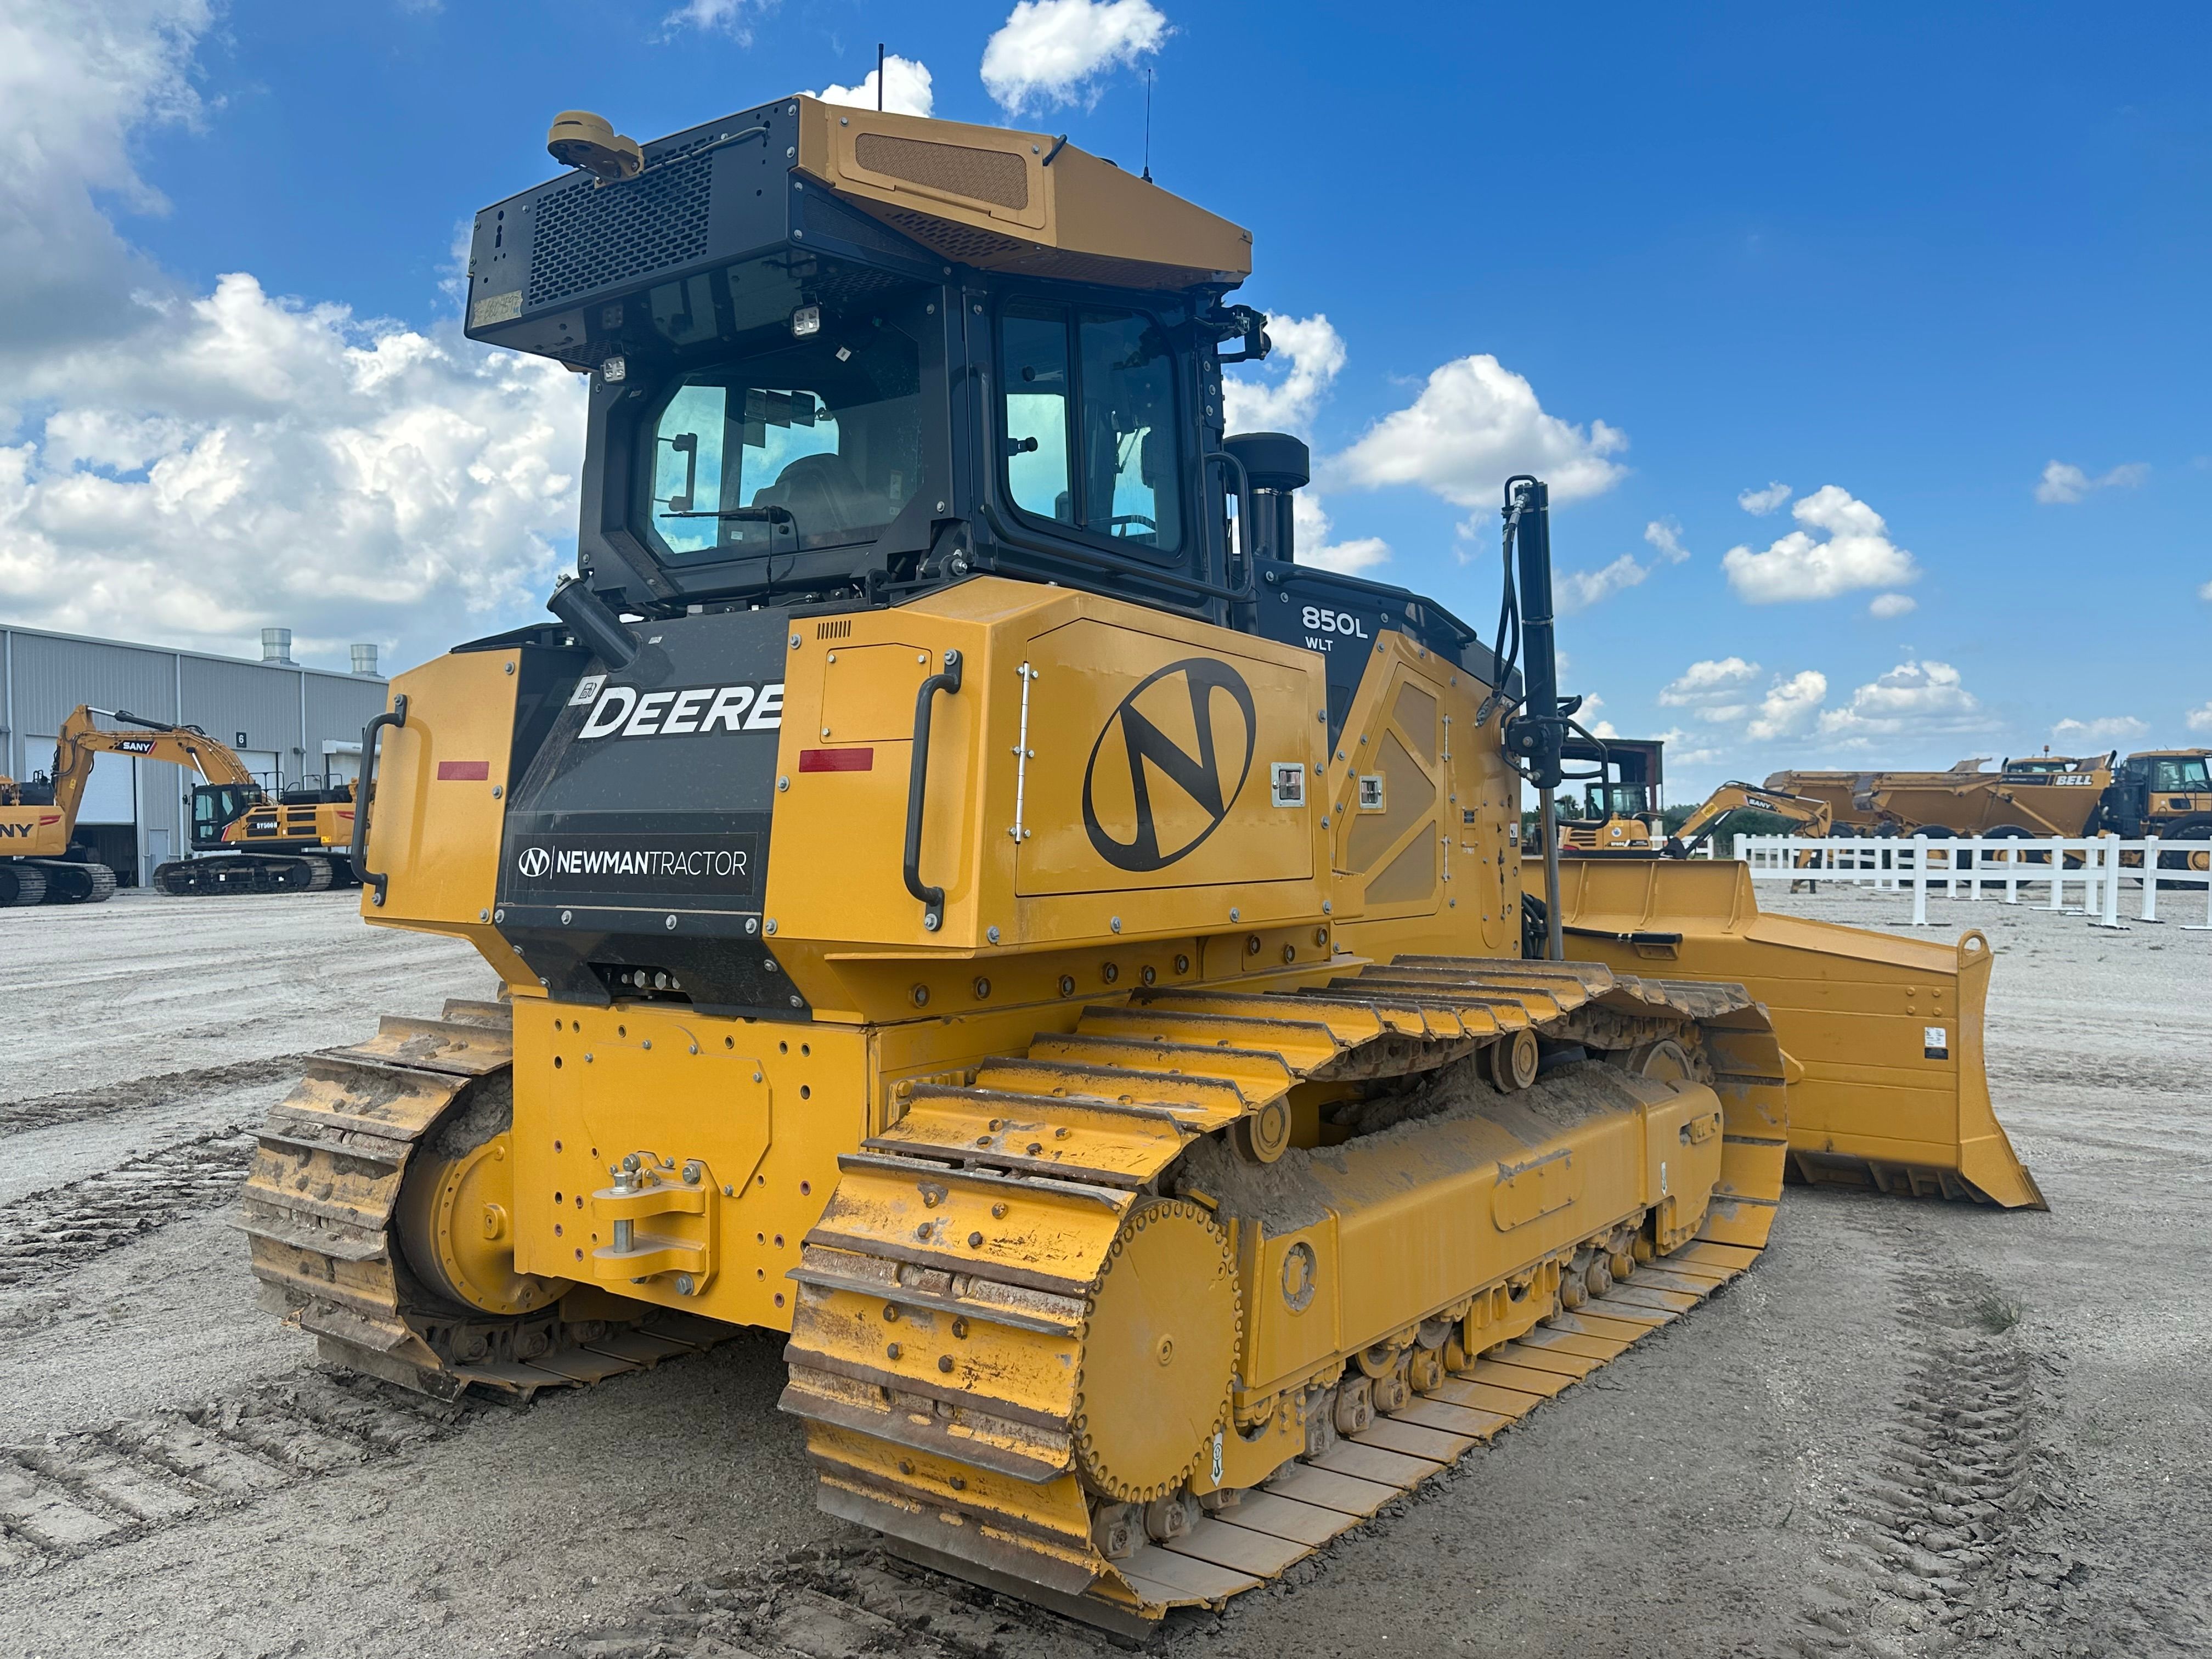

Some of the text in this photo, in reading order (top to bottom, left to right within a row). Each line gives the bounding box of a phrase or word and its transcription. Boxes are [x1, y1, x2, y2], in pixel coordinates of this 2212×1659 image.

[1302, 606, 1368, 639] 850L
[1305, 636, 1333, 651] WLT
[578, 684, 785, 739] DEERE
[238, 735, 244, 744] 6
[123, 742, 150, 751] SANY
[2056, 775, 2092, 786] BELL
[1749, 799, 1771, 809] SANY
